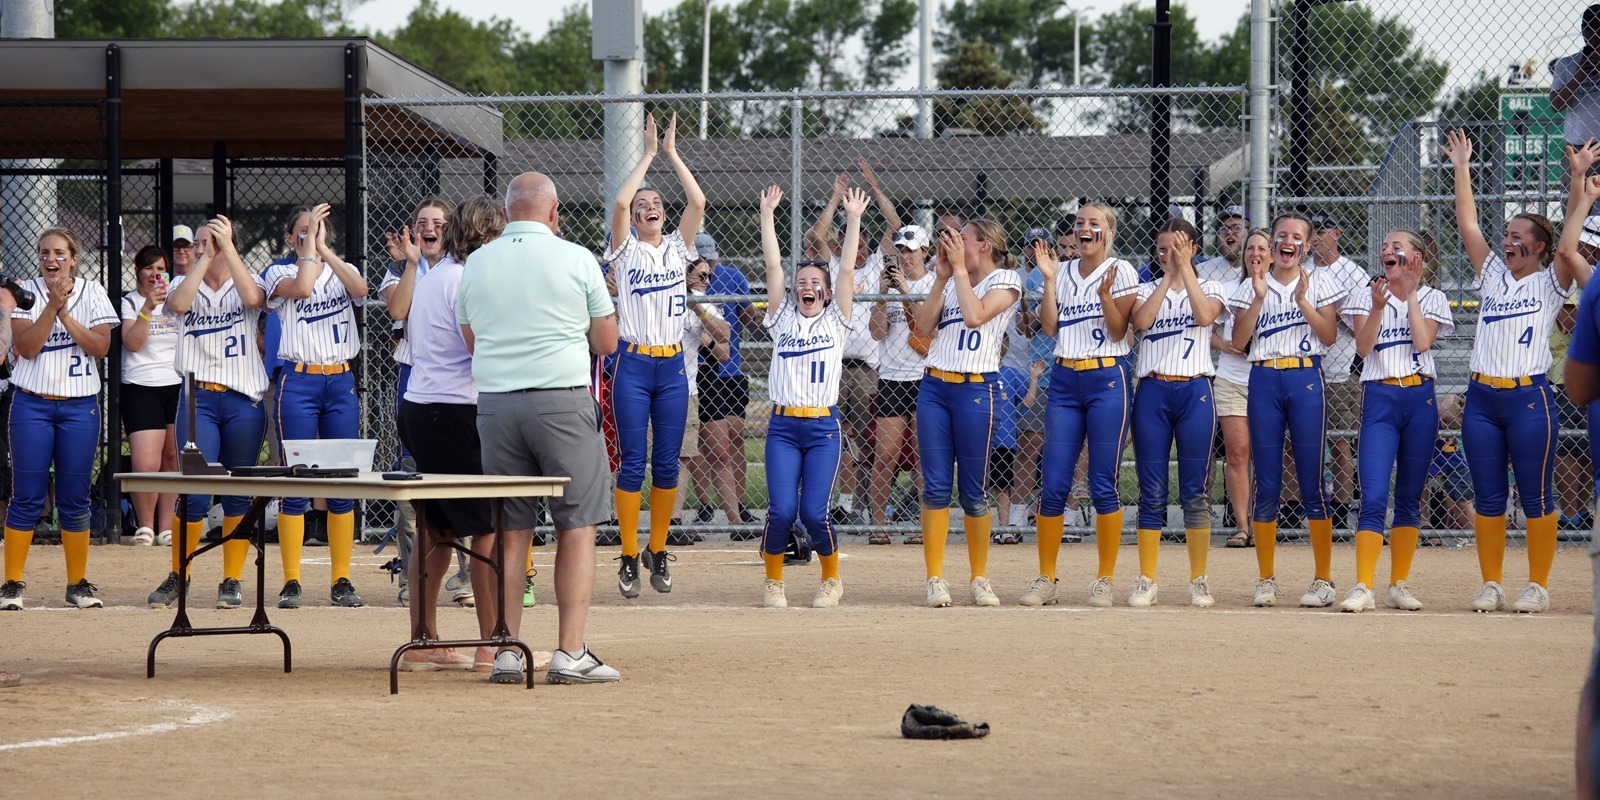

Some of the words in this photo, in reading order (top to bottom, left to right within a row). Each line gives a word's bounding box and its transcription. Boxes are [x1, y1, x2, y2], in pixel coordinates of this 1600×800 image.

[1508, 97, 1534, 110] BALL
[667, 294, 686, 318] 13
[1057, 301, 1103, 317] arrior
[1482, 296, 1538, 313] Warriors
[184, 306, 244, 327] Warriors
[1255, 307, 1304, 331] Warrio
[332, 320, 349, 345] 17
[957, 329, 982, 352] 10
[1091, 328, 1106, 349] 9
[1298, 333, 1312, 353] 6
[1517, 326, 1534, 349] 4
[224, 333, 247, 358] 21
[1181, 337, 1195, 360] 7
[810, 360, 826, 384] 11
